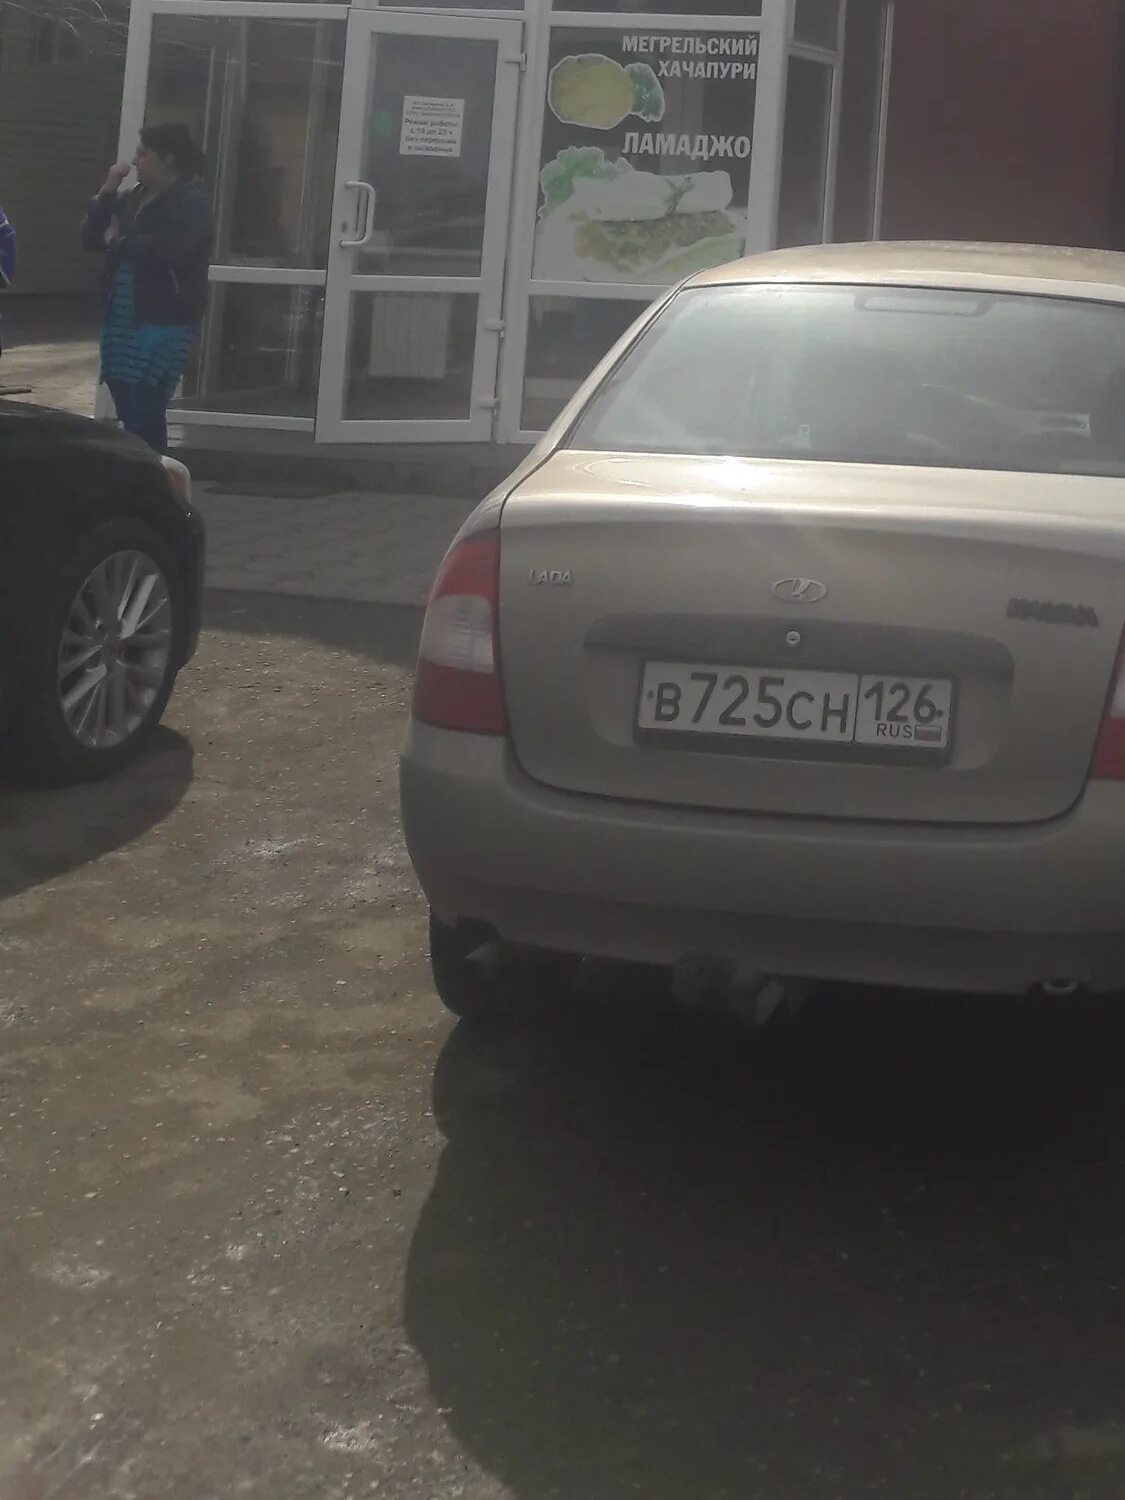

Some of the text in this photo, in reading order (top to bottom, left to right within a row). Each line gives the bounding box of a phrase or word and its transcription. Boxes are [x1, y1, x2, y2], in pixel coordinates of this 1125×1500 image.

[622, 34, 758, 56] МЕГРЕЛЬСКИЙ
[658, 60, 756, 80] ХАЧАПУРИ
[622, 132, 751, 161] ЛАМАДЖО
[863, 679, 937, 724] 126
[876, 723, 914, 740] RUS
